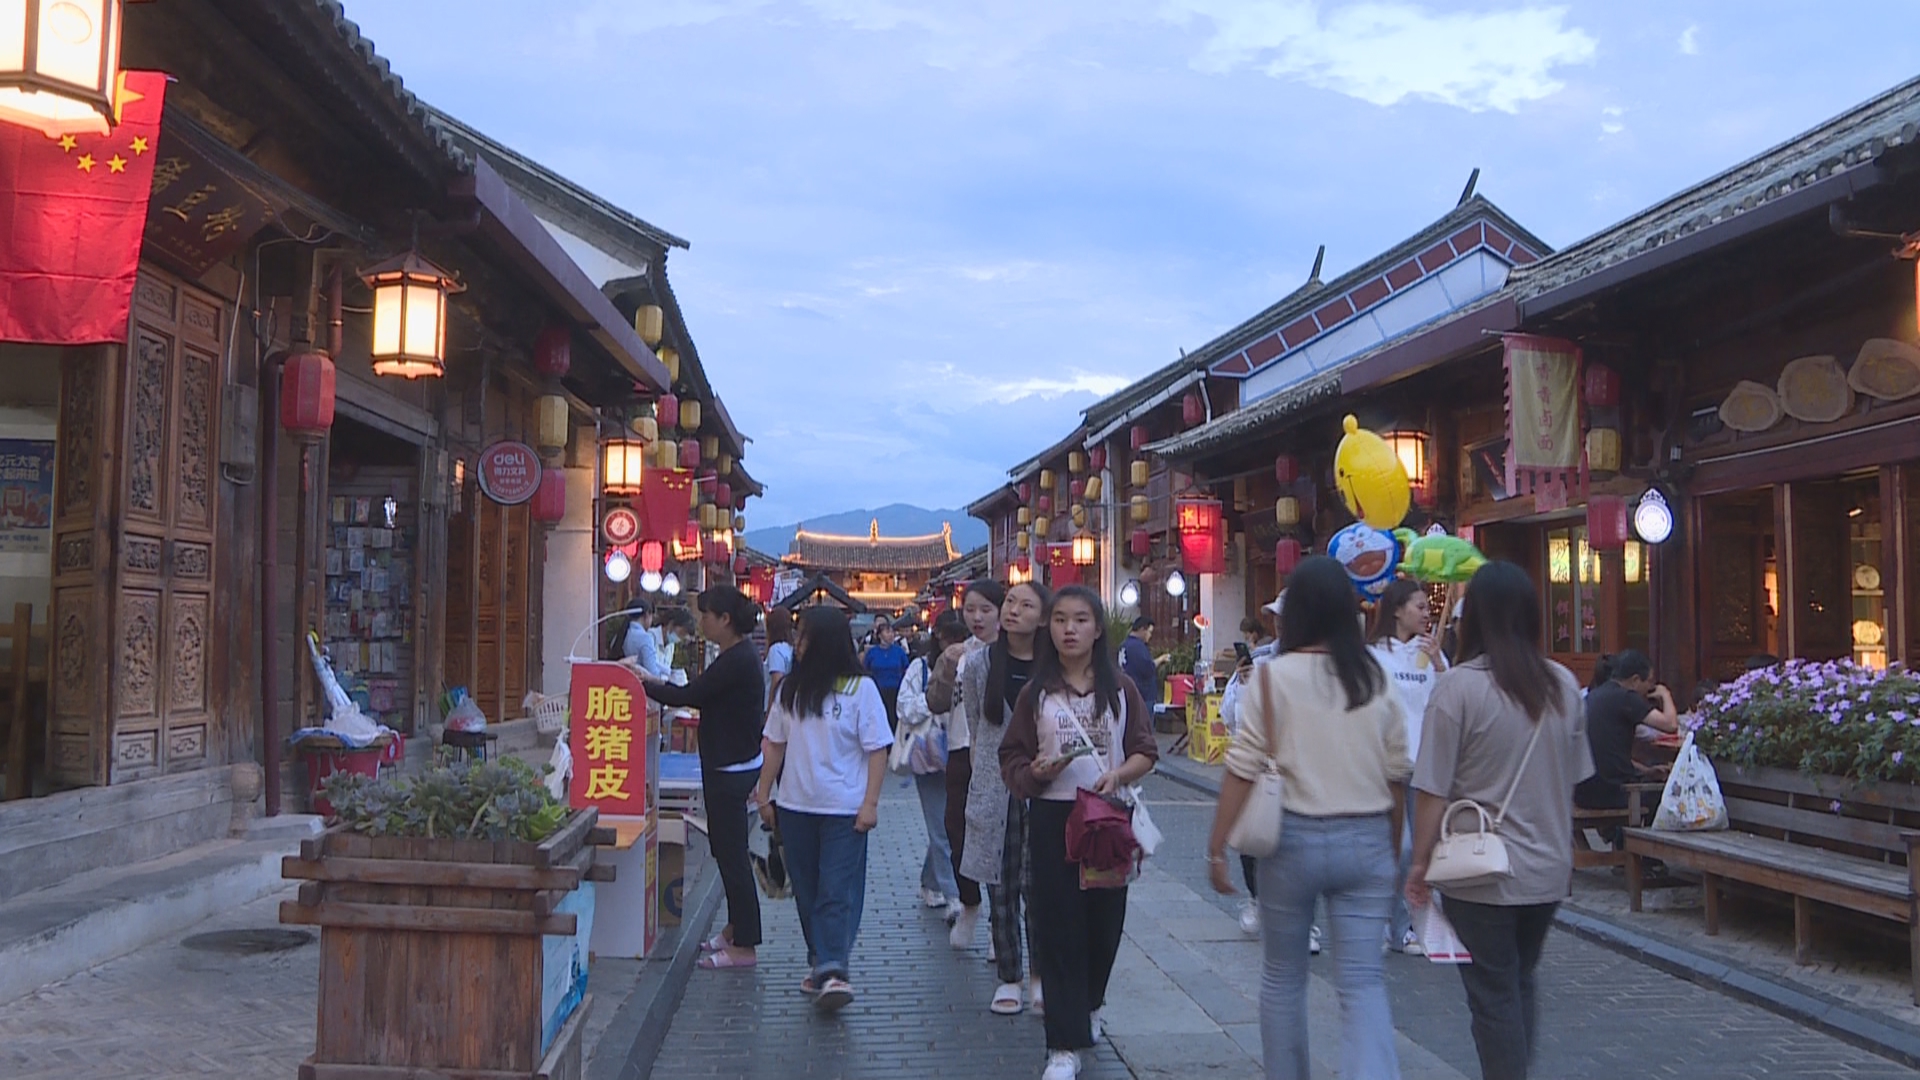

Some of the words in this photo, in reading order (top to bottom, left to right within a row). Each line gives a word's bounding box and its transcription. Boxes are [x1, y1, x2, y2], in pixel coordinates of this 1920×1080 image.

[493, 452, 525, 466] deli
[584, 685, 632, 800] 脆猪皮
